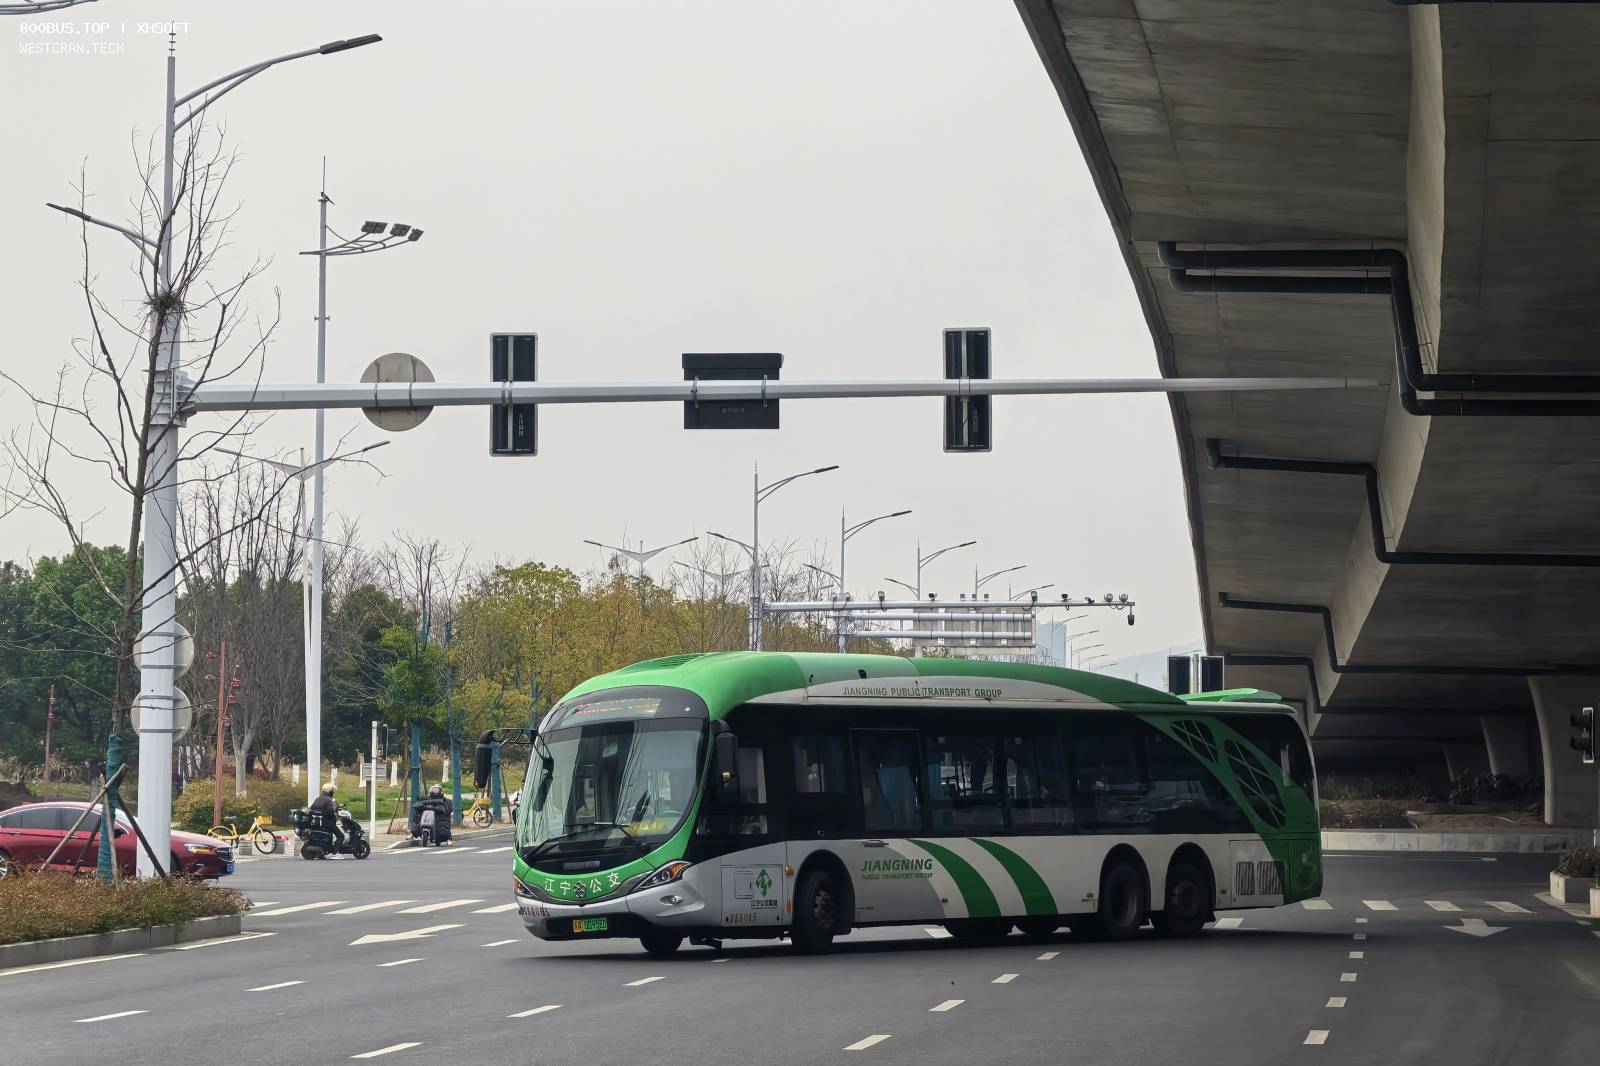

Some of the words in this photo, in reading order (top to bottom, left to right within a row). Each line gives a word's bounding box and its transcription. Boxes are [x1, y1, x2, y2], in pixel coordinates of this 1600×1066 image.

[843, 687, 888, 696] JIANGNING
[890, 687, 920, 696] PUBLIC
[922, 687, 971, 697] TRANSPORT
[974, 688, 1002, 698] GROUP
[861, 859, 933, 872] JIANGNING
